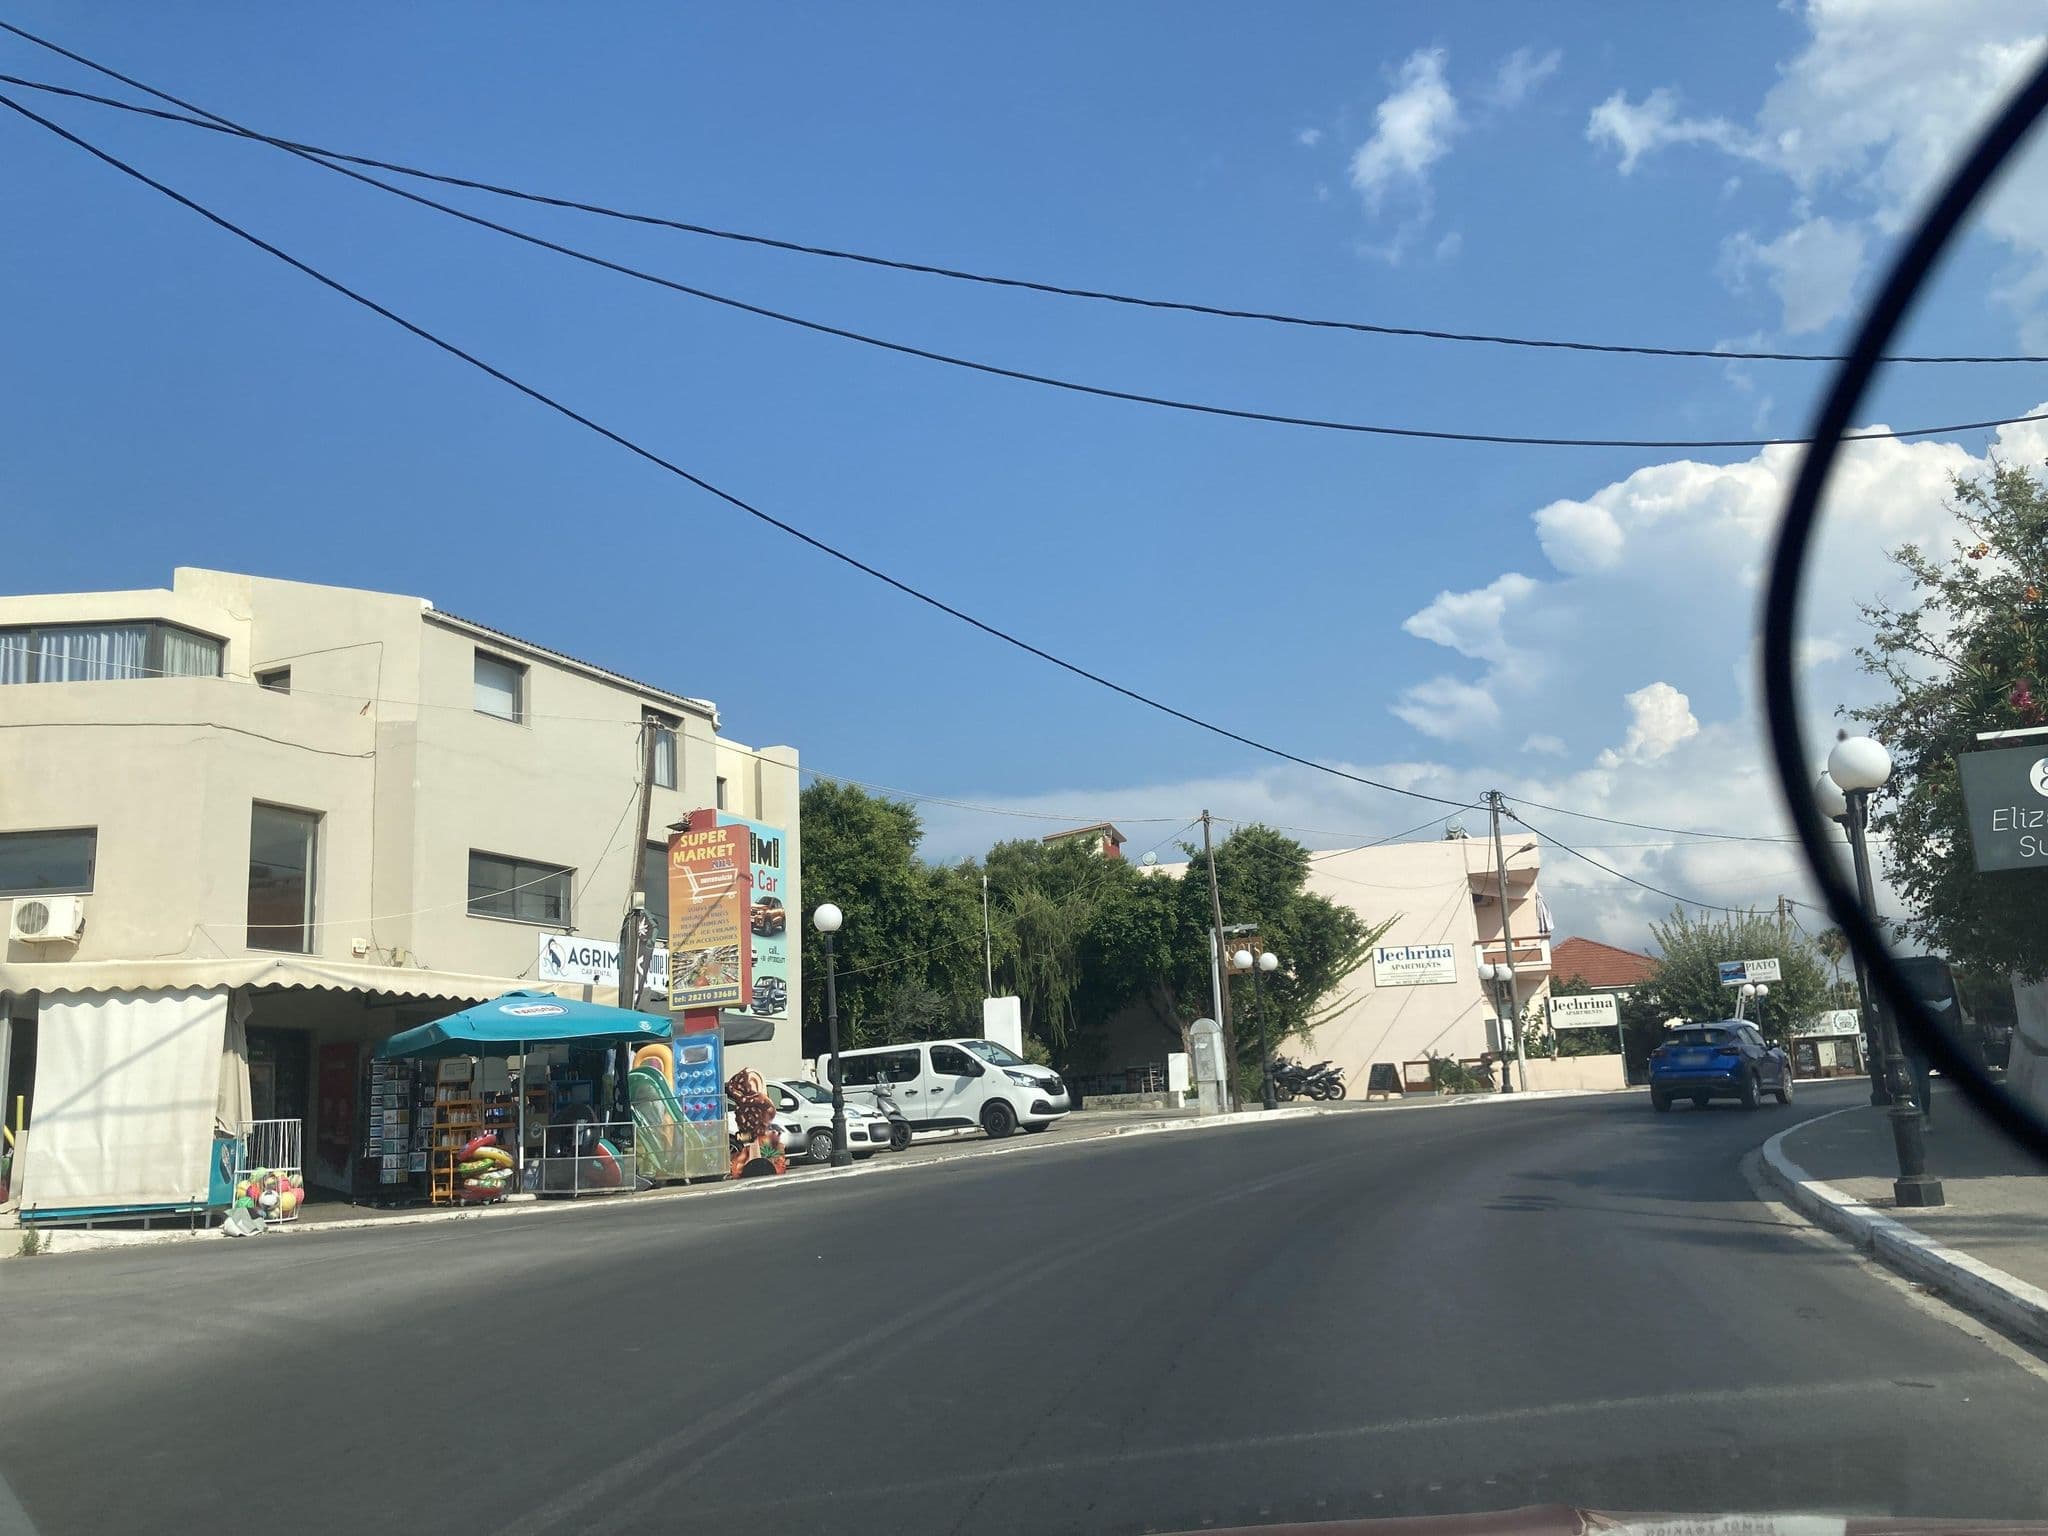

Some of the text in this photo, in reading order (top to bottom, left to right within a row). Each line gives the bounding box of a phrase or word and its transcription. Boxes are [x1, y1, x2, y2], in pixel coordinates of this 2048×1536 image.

[1992, 807, 2048, 831] Eliz
[680, 829, 727, 848] SUPER
[673, 843, 736, 863] MARKET
[758, 869, 778, 892] Car
[1377, 945, 1452, 964] Jechrina
[1391, 962, 1441, 971] APARTMENTS
[1745, 960, 1776, 971] PIATO
[1551, 997, 1613, 1013] Jechrina
